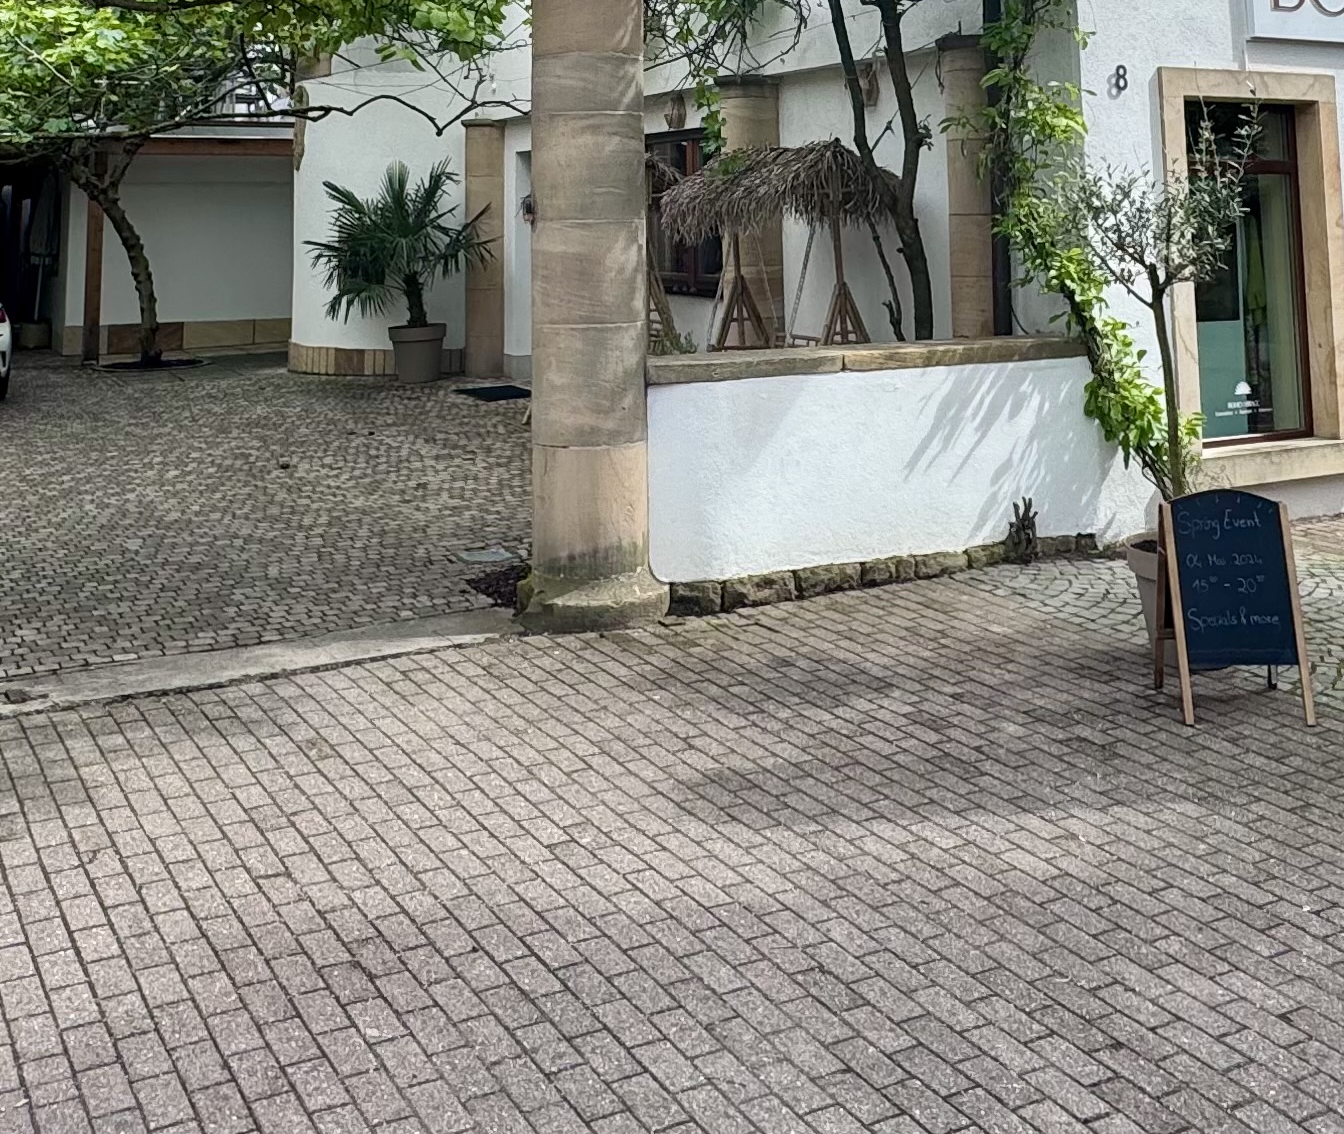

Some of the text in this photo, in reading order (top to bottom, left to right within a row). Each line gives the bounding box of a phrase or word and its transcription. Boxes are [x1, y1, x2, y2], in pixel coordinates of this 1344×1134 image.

[1116, 65, 1128, 91] 8
[1177, 509, 1261, 540] Spring Event
[1250, 615, 1280, 625] more
